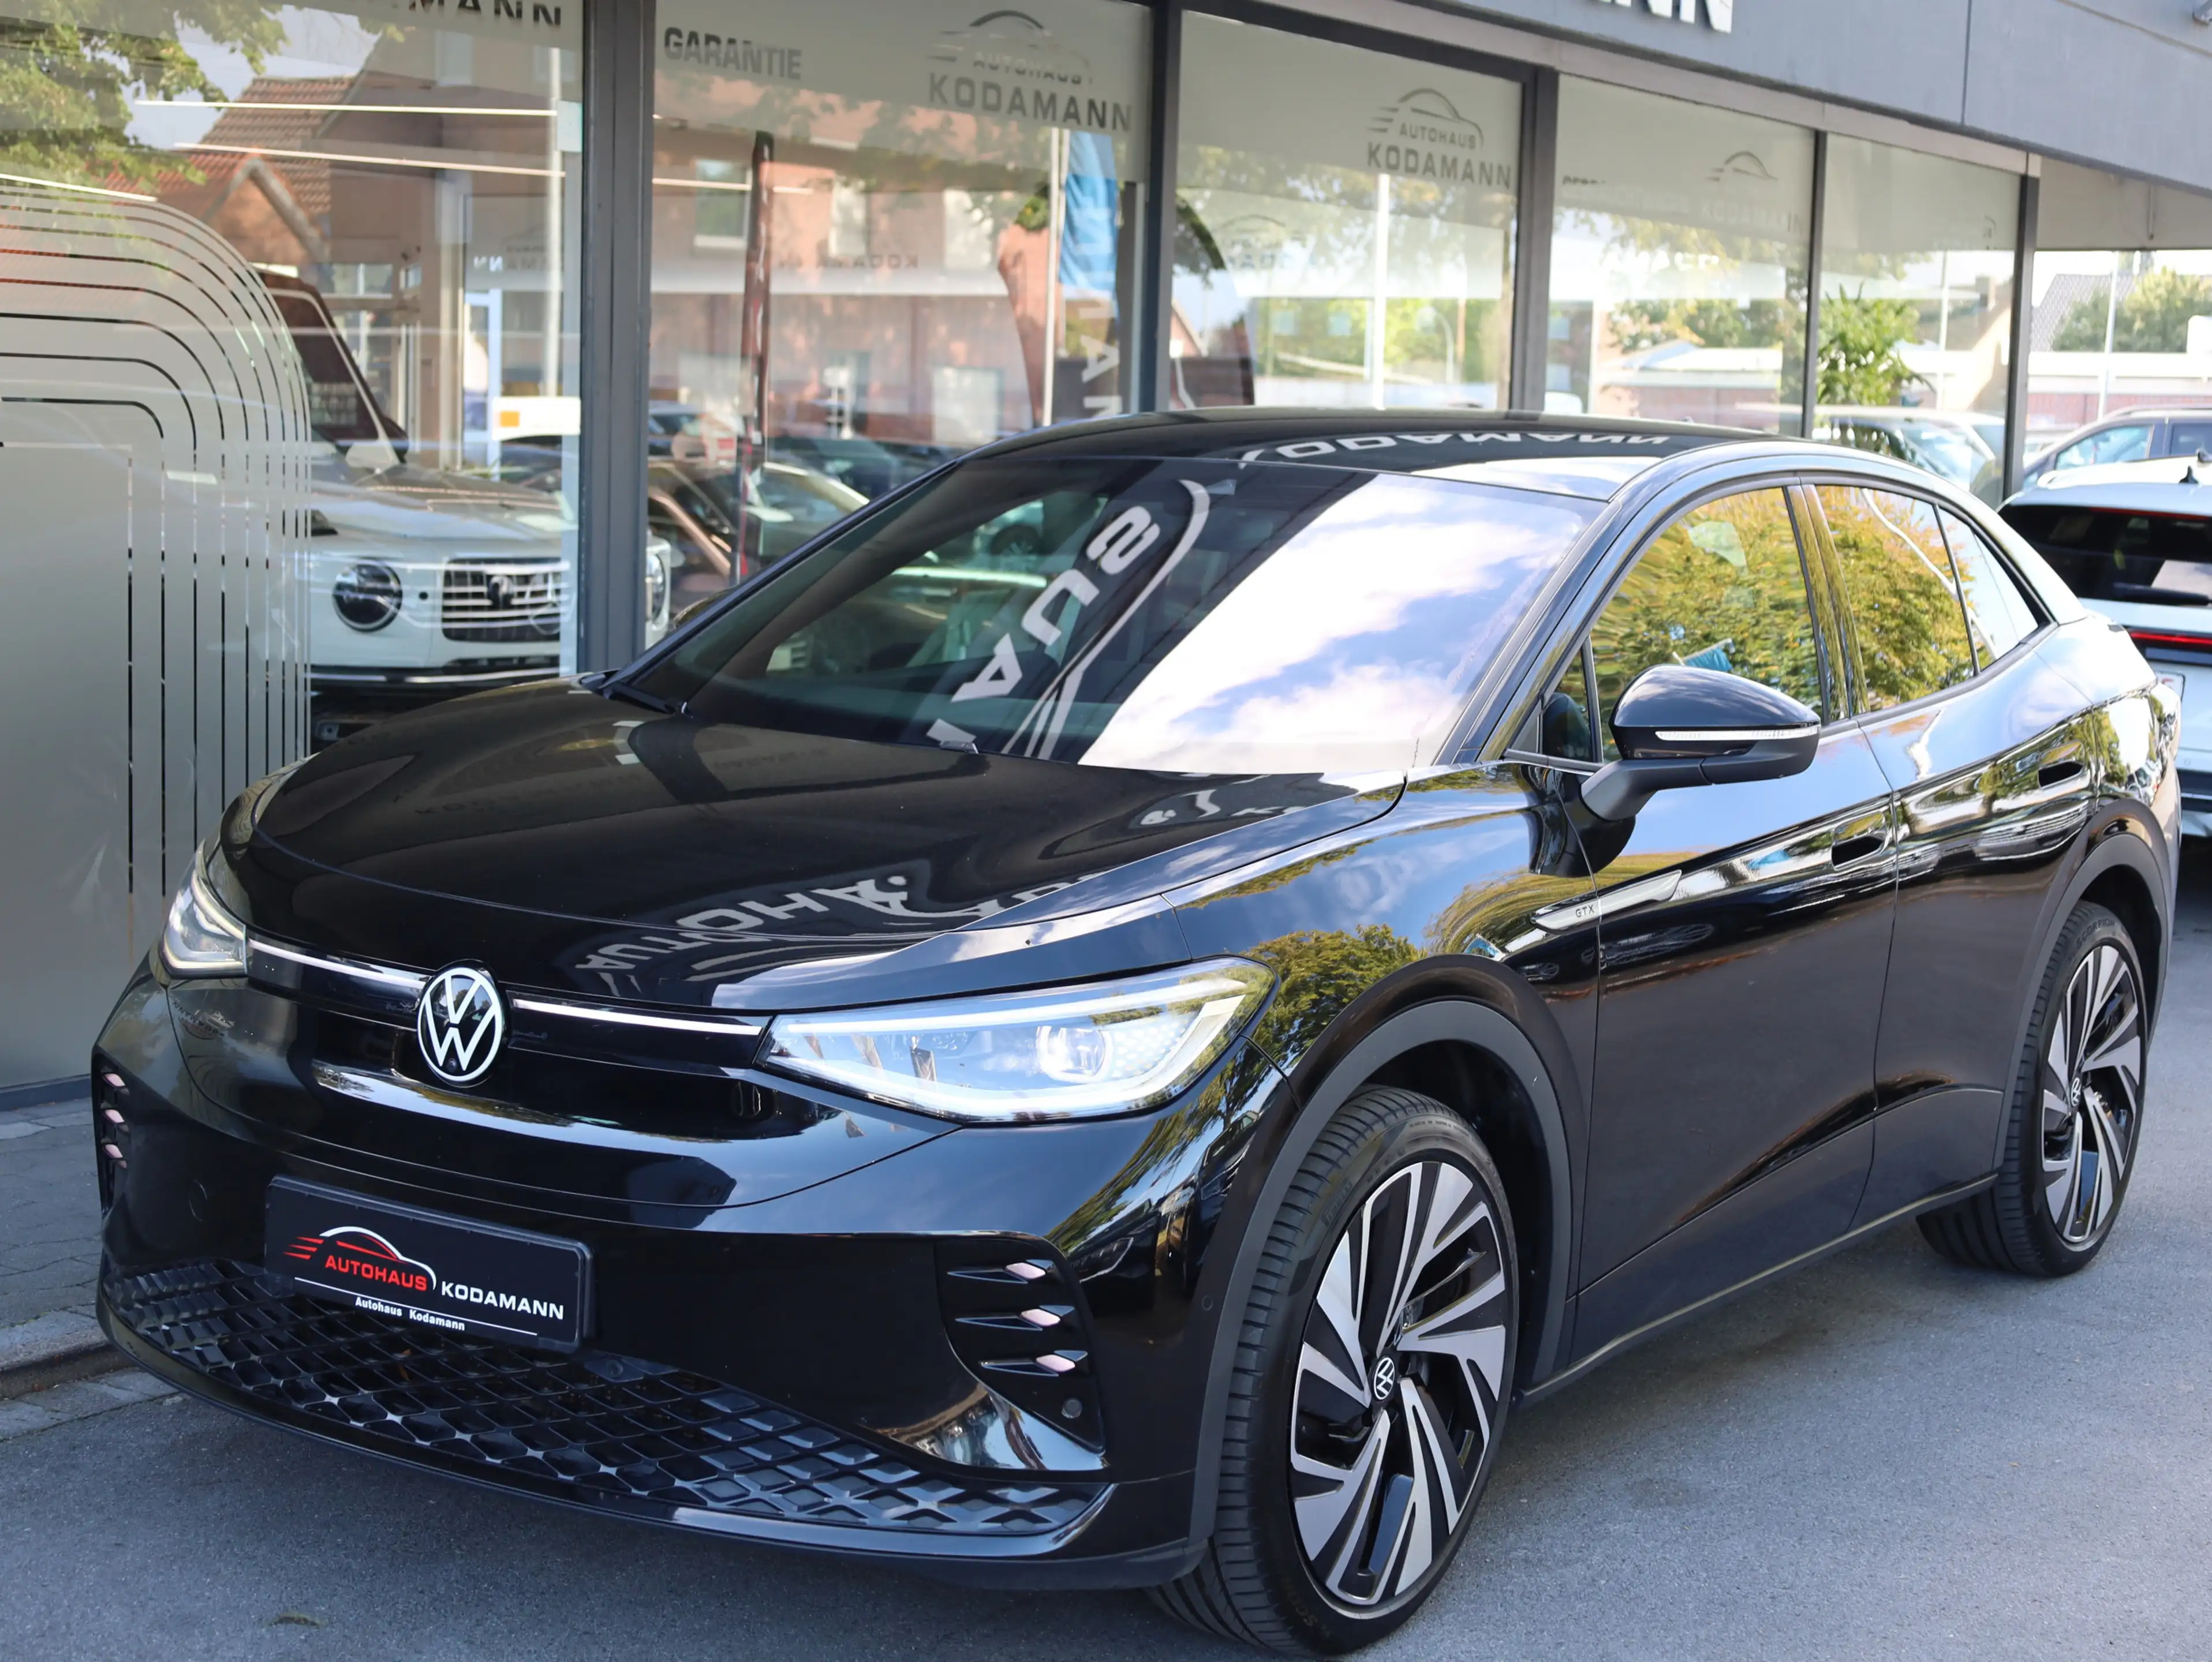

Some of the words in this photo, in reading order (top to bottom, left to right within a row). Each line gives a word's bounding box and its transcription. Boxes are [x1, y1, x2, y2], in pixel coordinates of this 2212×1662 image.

[664, 27, 802, 80] GARANTIE
[928, 72, 1133, 133] KODAMANN
[1399, 122, 1477, 151] AUTOHAUS
[1367, 141, 1512, 190] KODAMANN
[1576, 904, 1594, 918] GTX
[324, 1254, 428, 1292] AUTOHAUS
[355, 1296, 403, 1317] Autohaus
[409, 1308, 465, 1331] Kodamann
[442, 1281, 565, 1320] KODAMANN
